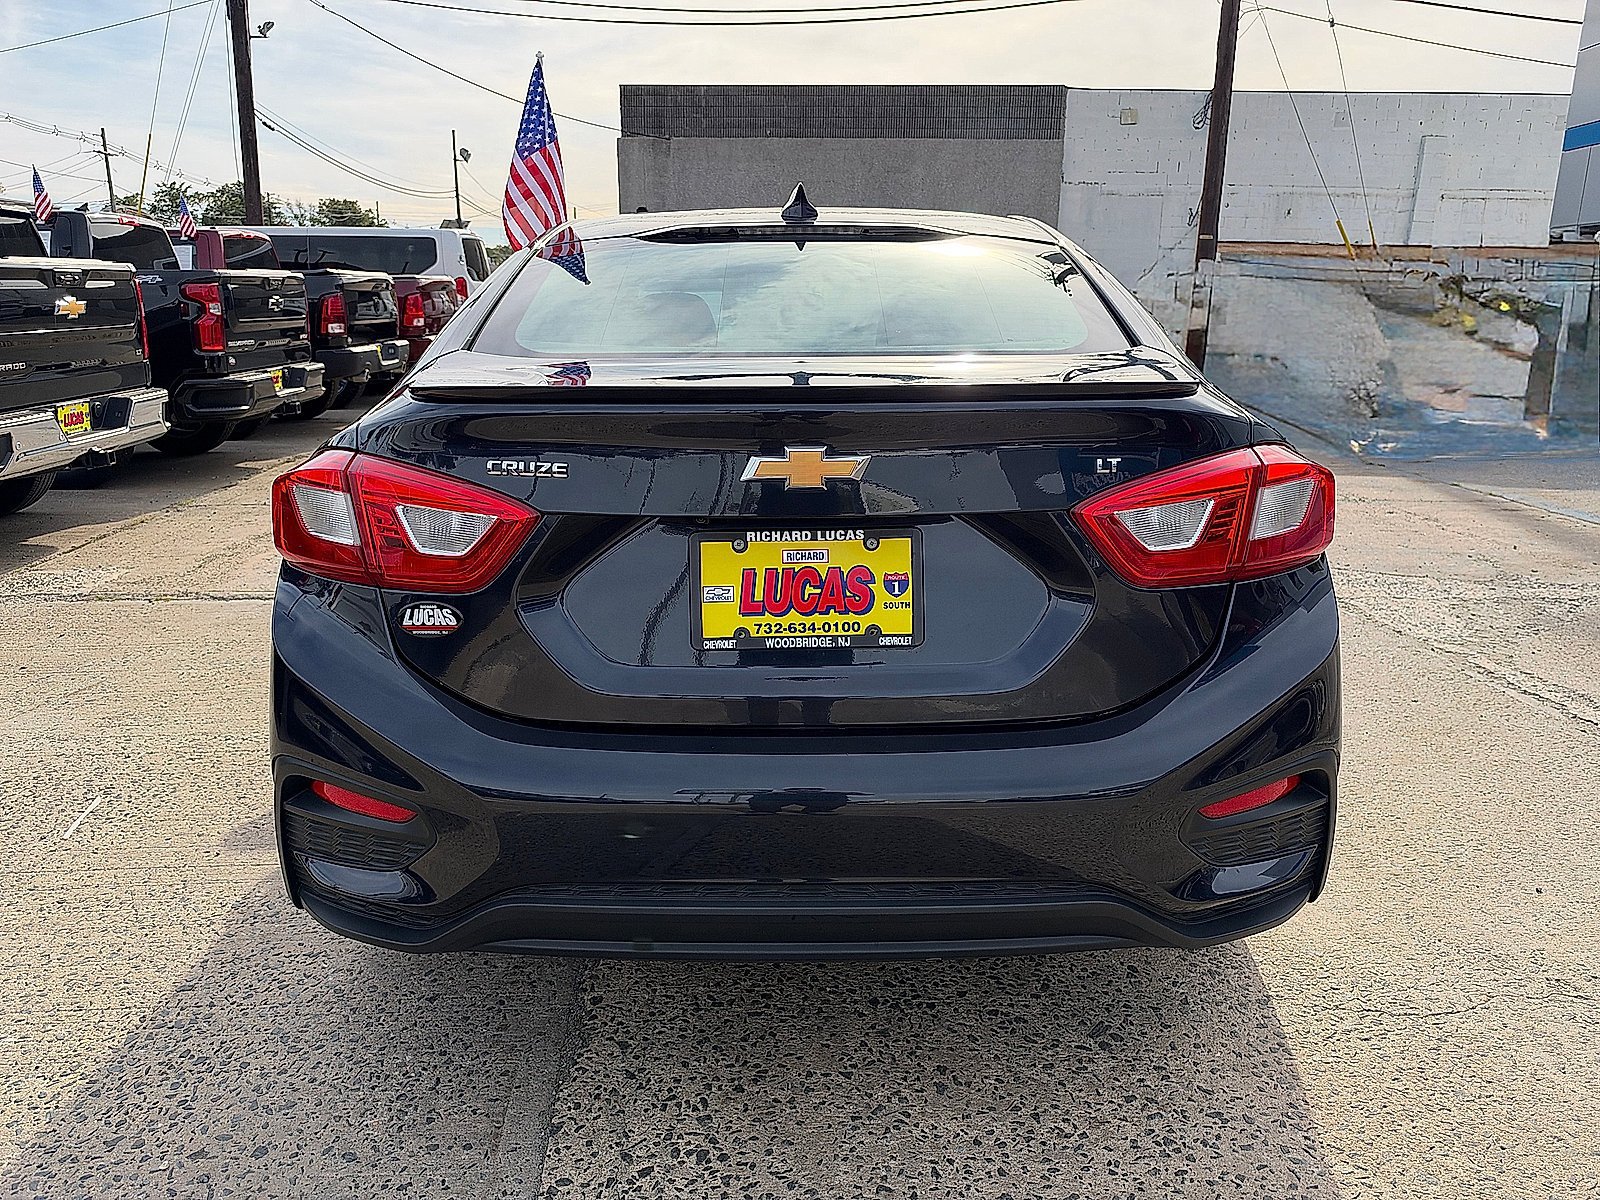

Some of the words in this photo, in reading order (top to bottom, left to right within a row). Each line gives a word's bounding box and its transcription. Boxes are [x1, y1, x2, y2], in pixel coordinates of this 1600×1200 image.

[63, 410, 85, 427] LUCAS
[486, 460, 568, 478] CRUZE
[1096, 457, 1122, 473] LT
[746, 531, 811, 542] RICHARD
[817, 529, 865, 541] LUCAS
[786, 551, 825, 562] RICHARD
[738, 565, 877, 617] LUCAS
[891, 580, 902, 595] 1
[883, 601, 911, 609] SOUTH
[402, 608, 458, 626] LUCAS
[753, 621, 861, 635] 732-634-0100
[703, 639, 737, 650] CHEVROLET
[764, 637, 836, 649] WOODBRIDGE,
[838, 636, 851, 647] NJ
[879, 636, 913, 646] CHEVROLET
